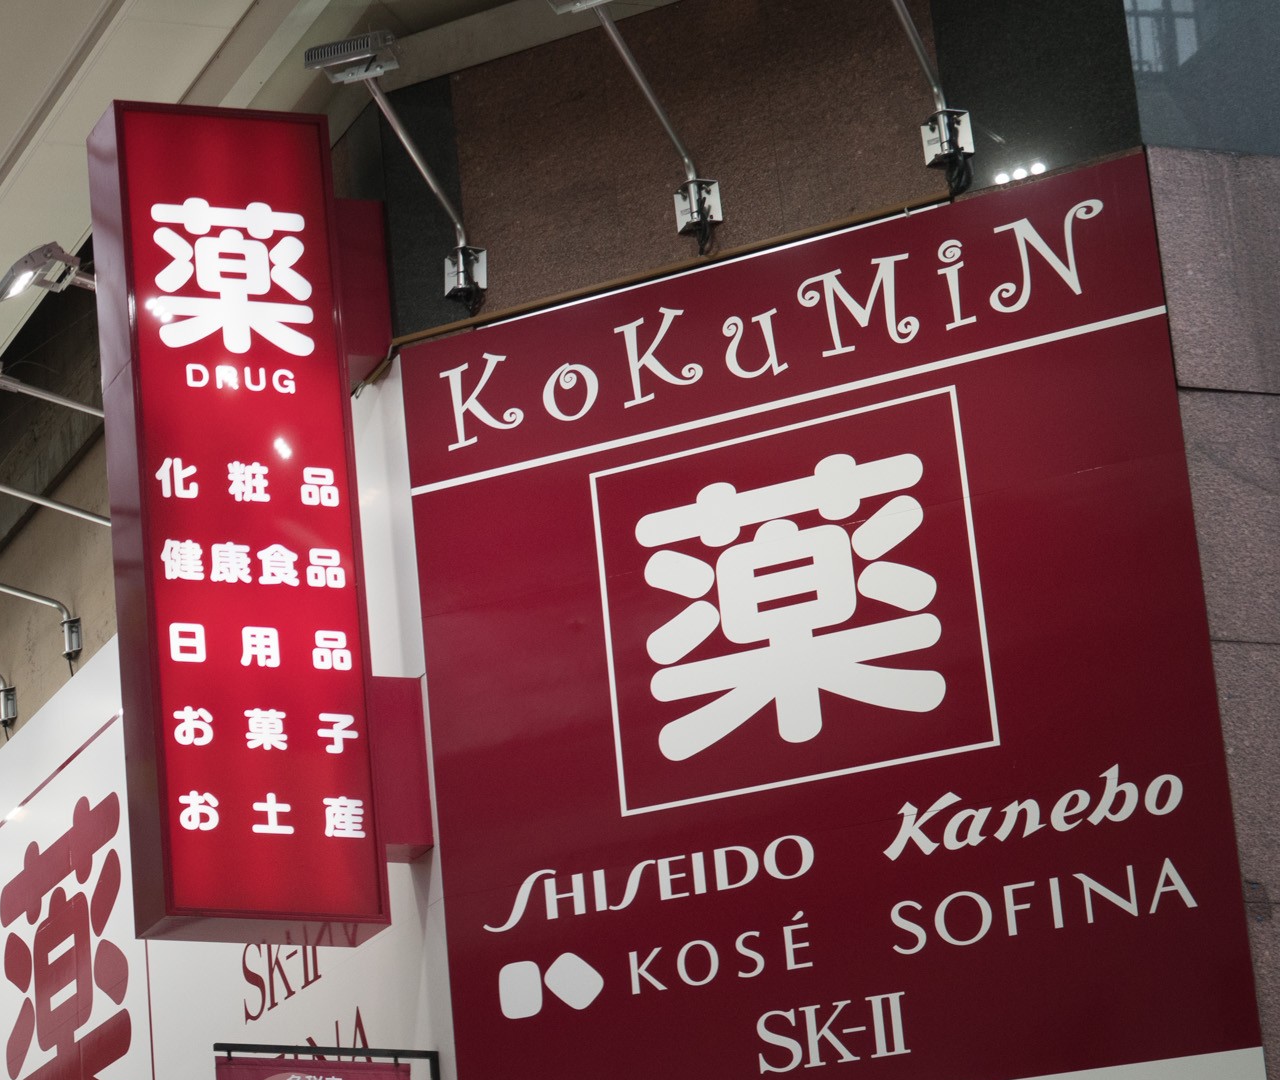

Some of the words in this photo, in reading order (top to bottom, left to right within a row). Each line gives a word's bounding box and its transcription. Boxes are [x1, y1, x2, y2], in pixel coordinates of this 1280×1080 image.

[150, 197, 315, 357] 薬
[186, 363, 297, 395] DRUG
[155, 457, 340, 508] 化粧品
[160, 538, 346, 589] 健康食品
[635, 454, 947, 762] 薬
[168, 622, 353, 671] 日用品
[173, 705, 359, 754] お菓子
[178, 789, 366, 839] お土産
[882, 763, 1185, 862] Kanebo
[483, 834, 815, 934] SHISEIDO
[889, 857, 1199, 956] SOFINA
[628, 910, 814, 995] KOSÉ
